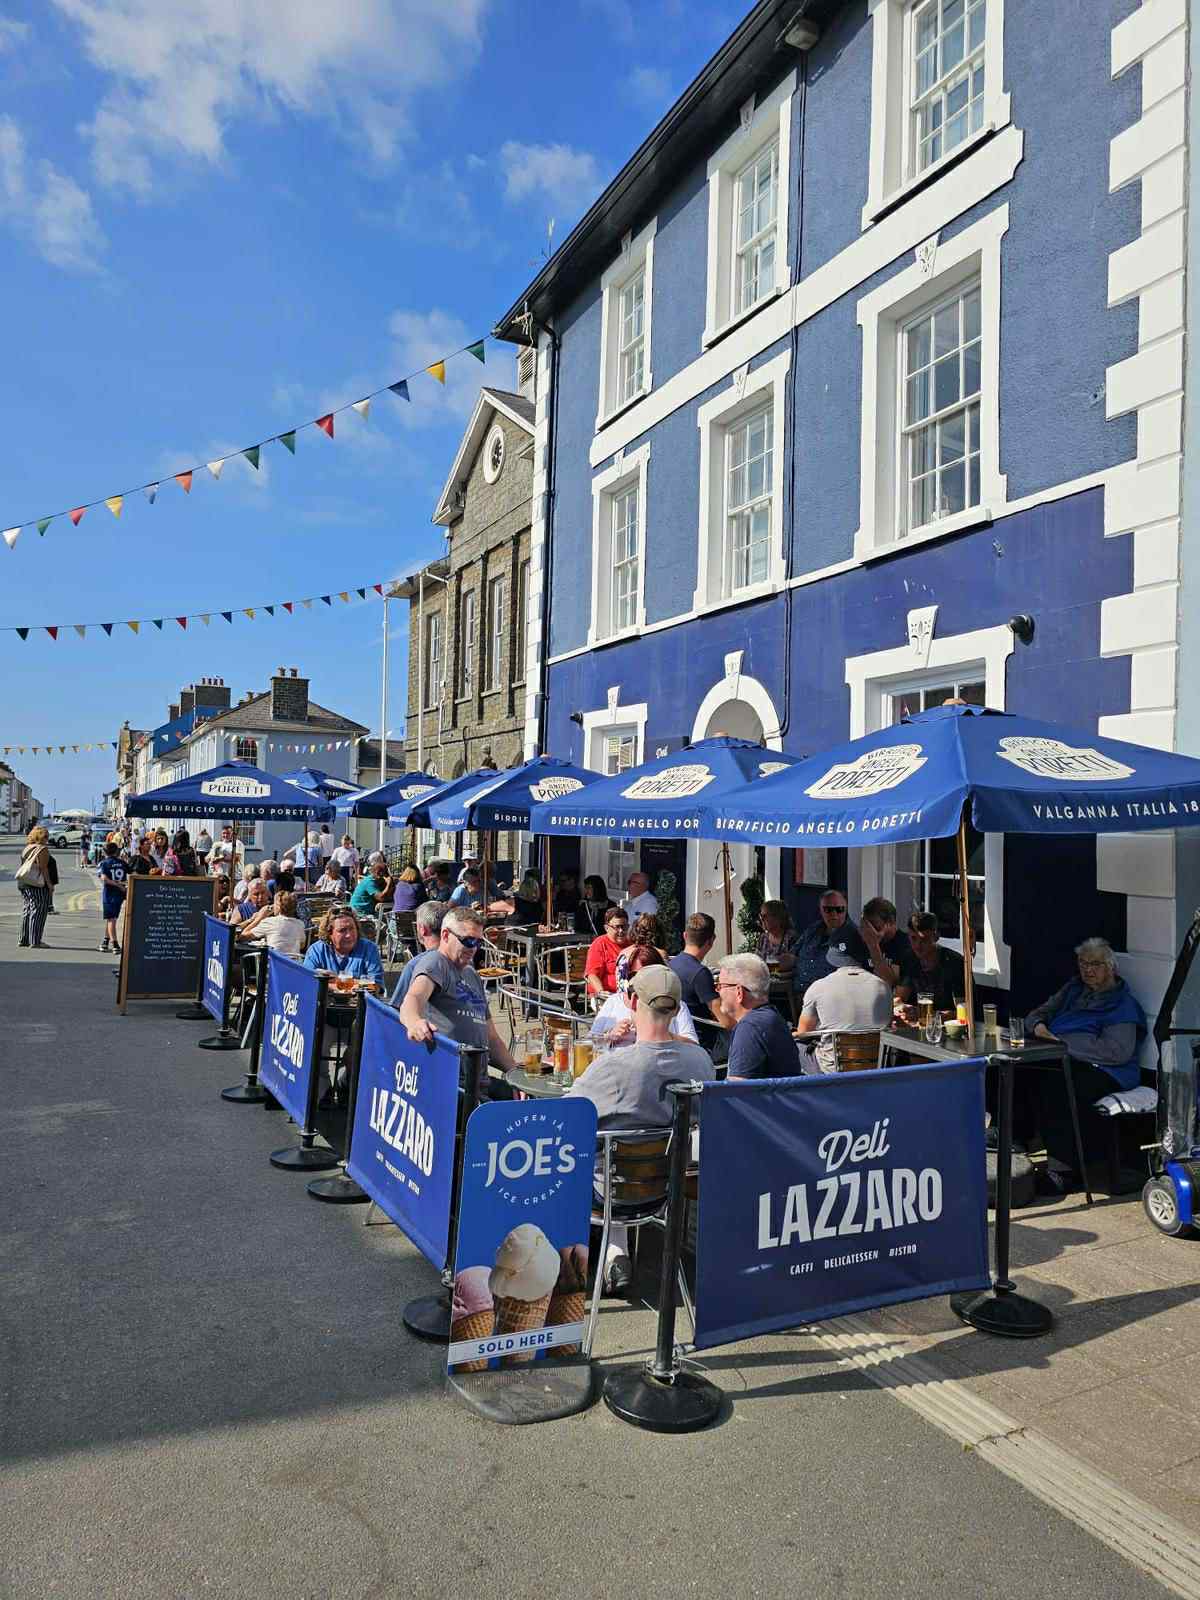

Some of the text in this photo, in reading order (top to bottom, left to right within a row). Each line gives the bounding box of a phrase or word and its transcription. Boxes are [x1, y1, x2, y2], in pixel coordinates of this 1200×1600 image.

[152, 804, 315, 817] BIRRIFICIO ANGELO PORETTI
[551, 816, 616, 827] BIRRIFICIO
[622, 818, 669, 828] ANGELO
[716, 810, 922, 834] BIRRIFICIO ANGELO PORETTI
[1033, 804, 1119, 819] VALGANNA
[1127, 801, 1178, 816] ITALIA
[395, 1060, 419, 1097] Deli
[369, 1087, 434, 1177] LAZZARO
[506, 1114, 547, 1134] HUFEN
[818, 1117, 891, 1173] Deli
[498, 1179, 563, 1205] ICE CREAM
[757, 1168, 943, 1250] LAZZARO
[790, 1244, 917, 1275] CAFFI DELICATESSEN BISTRO
[478, 1332, 553, 1354] SOLD HERE
